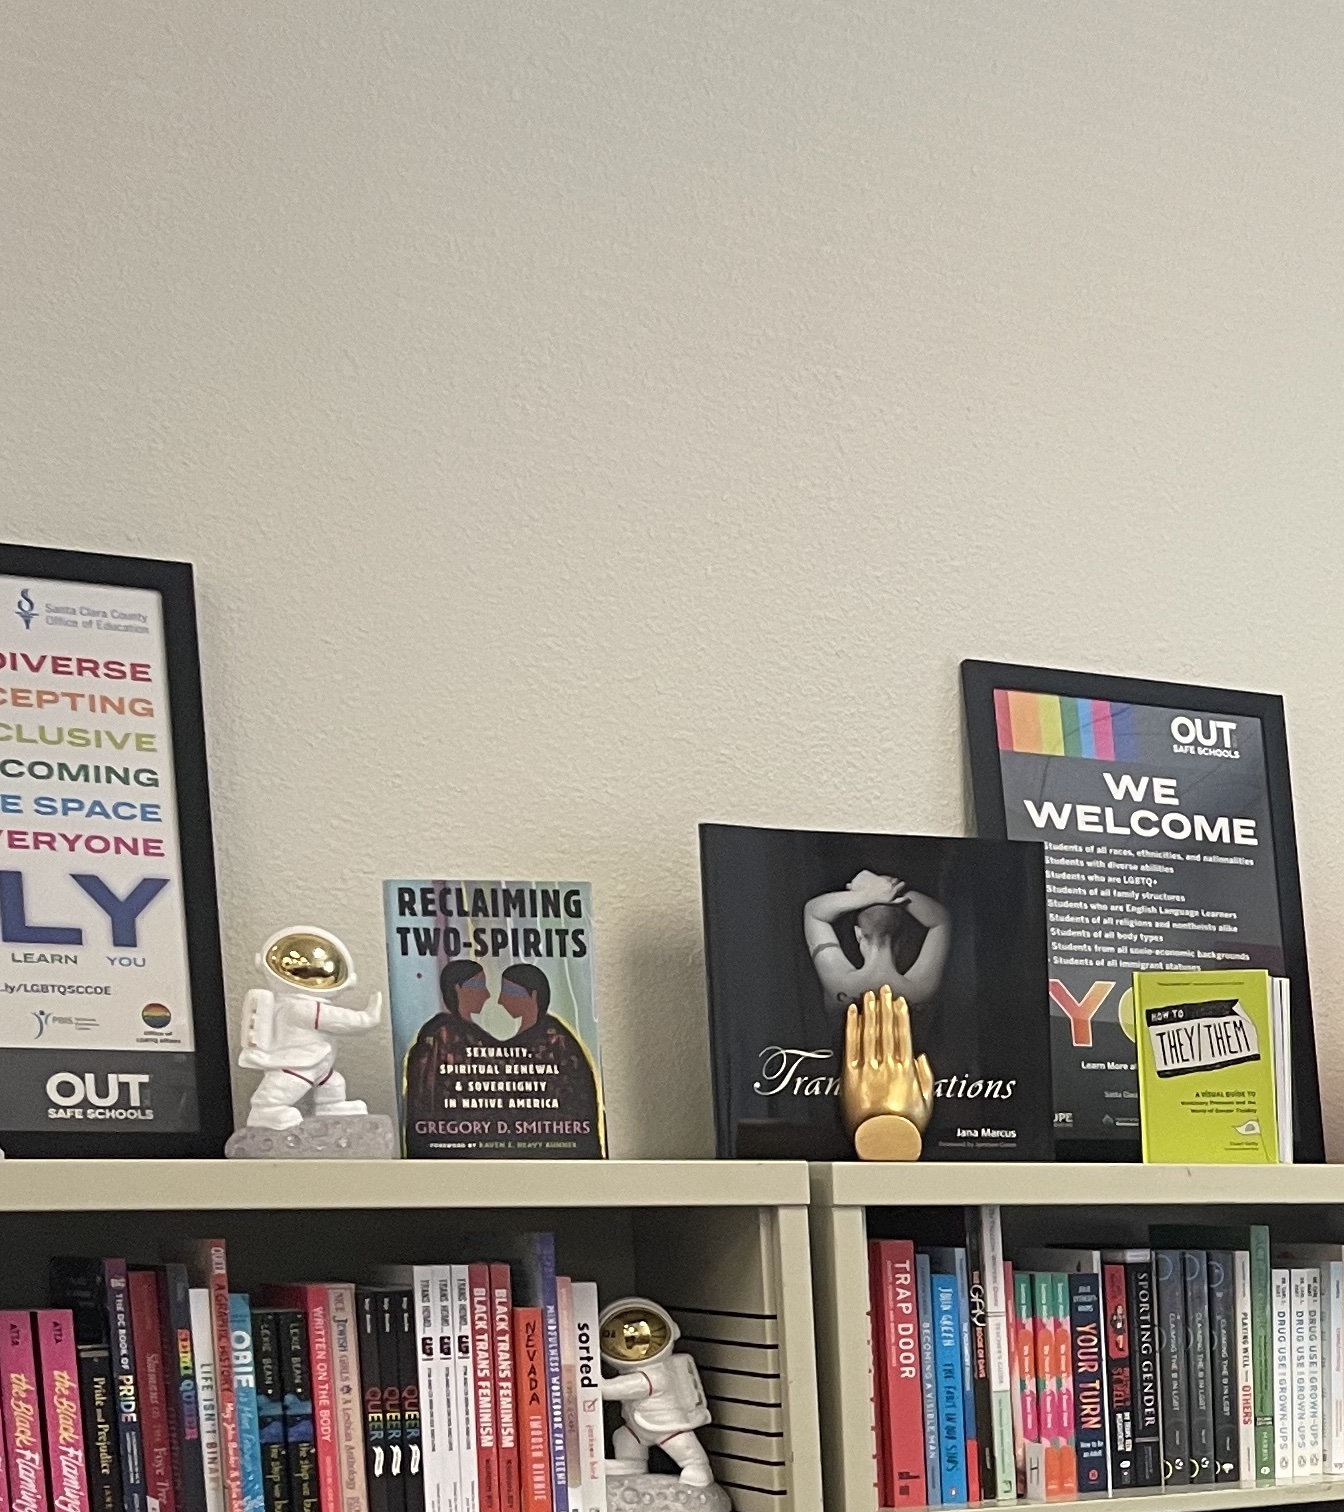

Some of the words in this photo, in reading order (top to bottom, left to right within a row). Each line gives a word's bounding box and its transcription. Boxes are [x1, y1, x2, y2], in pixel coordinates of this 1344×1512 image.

[45, 603, 76, 616] Santa
[80, 606, 107, 618] Clara
[111, 609, 147, 623] County
[1170, 716, 1237, 749] OUT
[1, 759, 159, 788] COMING
[1102, 772, 1180, 805] WE
[33, 797, 162, 822] SPACE
[1023, 800, 1258, 846] WELCOME
[398, 886, 582, 919] RECLAIMING
[396, 927, 587, 958] TWO-SPIRITS
[11, 953, 78, 964] LEARN
[106, 956, 146, 967] YOU
[1151, 1011, 1169, 1022] HOW
[1172, 1009, 1184, 1019] TO
[466, 1047, 532, 1058] SEXUALITY,
[1156, 1020, 1251, 1066] THEY/THEM
[440, 1065, 500, 1075] SPIRITUAL
[505, 1065, 559, 1075] RENEWAL
[46, 1072, 150, 1108] OUT
[445, 1098, 457, 1109] IN
[463, 1098, 503, 1109] NATIVE
[509, 1098, 559, 1109] AMERICA
[48, 1108, 83, 1119] SAFE
[87, 1109, 154, 1120] SCHOOLS
[415, 1121, 490, 1135] GREGORY
[498, 1121, 511, 1134] D.
[516, 1121, 590, 1134] SMITHERS
[956, 1128, 979, 1138] Jana
[981, 1128, 1017, 1138] Marcus
[1137, 1273, 1153, 1357] SPORTING
[1277, 1311, 1286, 1343] DRUG
[309, 1306, 326, 1360] WRITTEN
[1075, 1323, 1098, 1374] YOUR
[316, 1362, 328, 1376] ON
[525, 1322, 540, 1406] NEVADA
[577, 1322, 598, 1388] sorted
[1277, 1349, 1287, 1370] USE
[317, 1377, 329, 1406] THE
[1078, 1380, 1102, 1430] TURN
[1141, 1362, 1156, 1427] GENDER
[317, 1408, 332, 1443] BODY
[1278, 1379, 1288, 1450] GROWN-UPS
